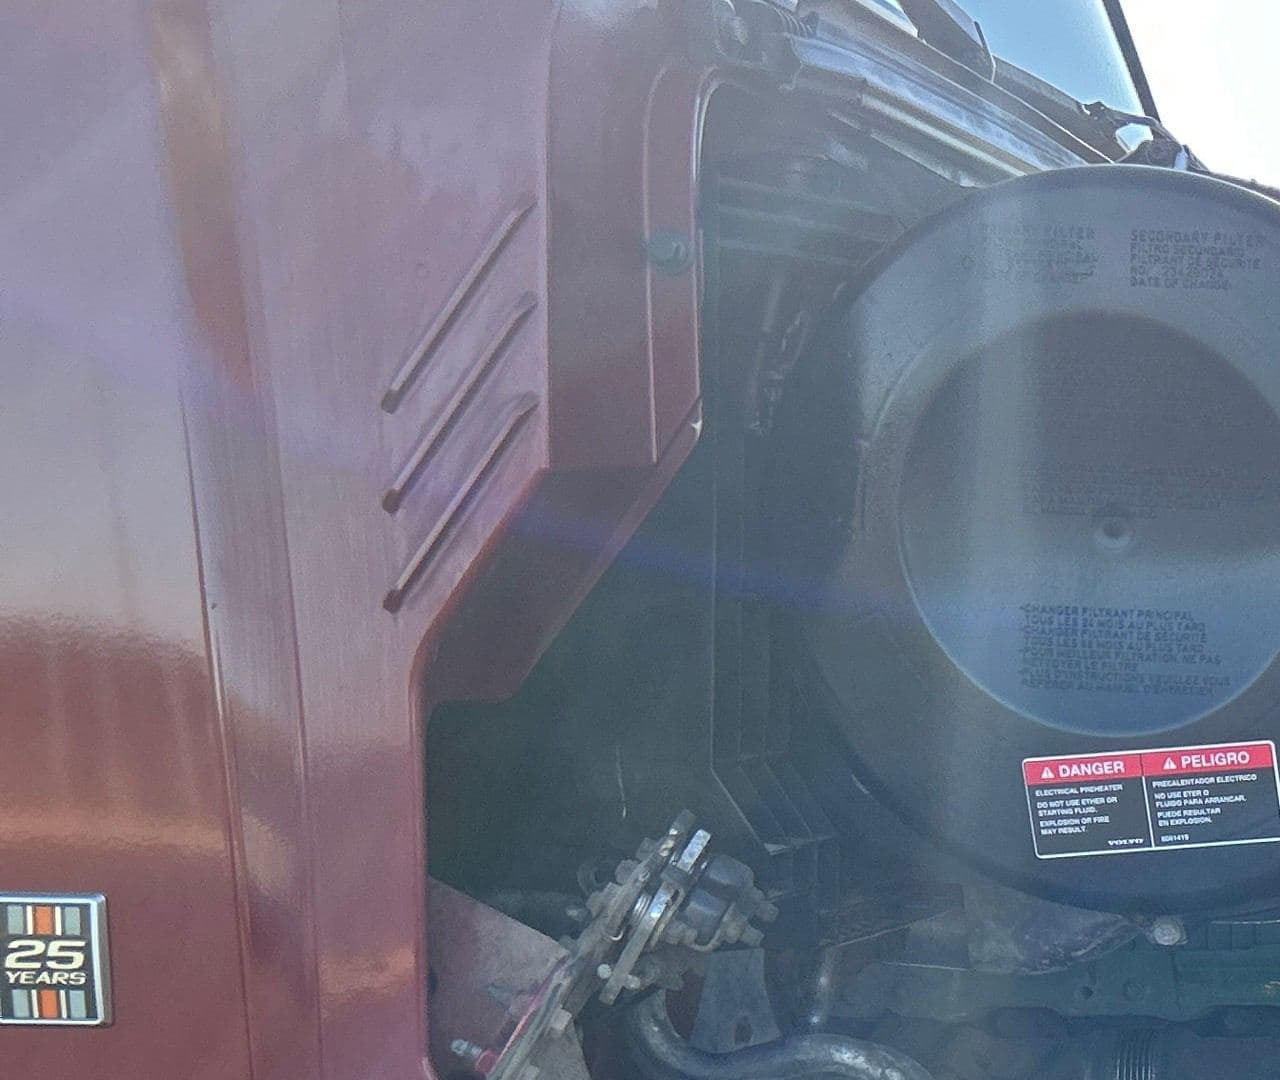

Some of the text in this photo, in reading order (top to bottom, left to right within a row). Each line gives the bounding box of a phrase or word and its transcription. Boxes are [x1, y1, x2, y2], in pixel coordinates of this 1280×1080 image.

[1180, 751, 1250, 768] PELIGRO
[1058, 761, 1125, 778] DANGER
[1152, 776, 1215, 788] PRECALENTADOR
[1035, 784, 1123, 797] ELECTRICAL PREHEATER
[1154, 792, 1166, 800] NO
[1167, 791, 1181, 799] USE
[1183, 790, 1202, 798] ETER
[1037, 796, 1118, 809] DO NOT USE ETHER OR
[1155, 799, 1182, 808] FLUIDO
[1183, 798, 1204, 806] PARA
[1038, 806, 1098, 817] STARTING FLUID.
[1157, 807, 1221, 818] PUEDE RESULTAR
[1040, 818, 1080, 828] EXPLOSION
[1159, 819, 1169, 827] EN
[1040, 827, 1056, 835] MAY
[1108, 838, 1144, 846] VOLVO
[4, 939, 86, 969] 25
[5, 971, 87, 985] YEARS
